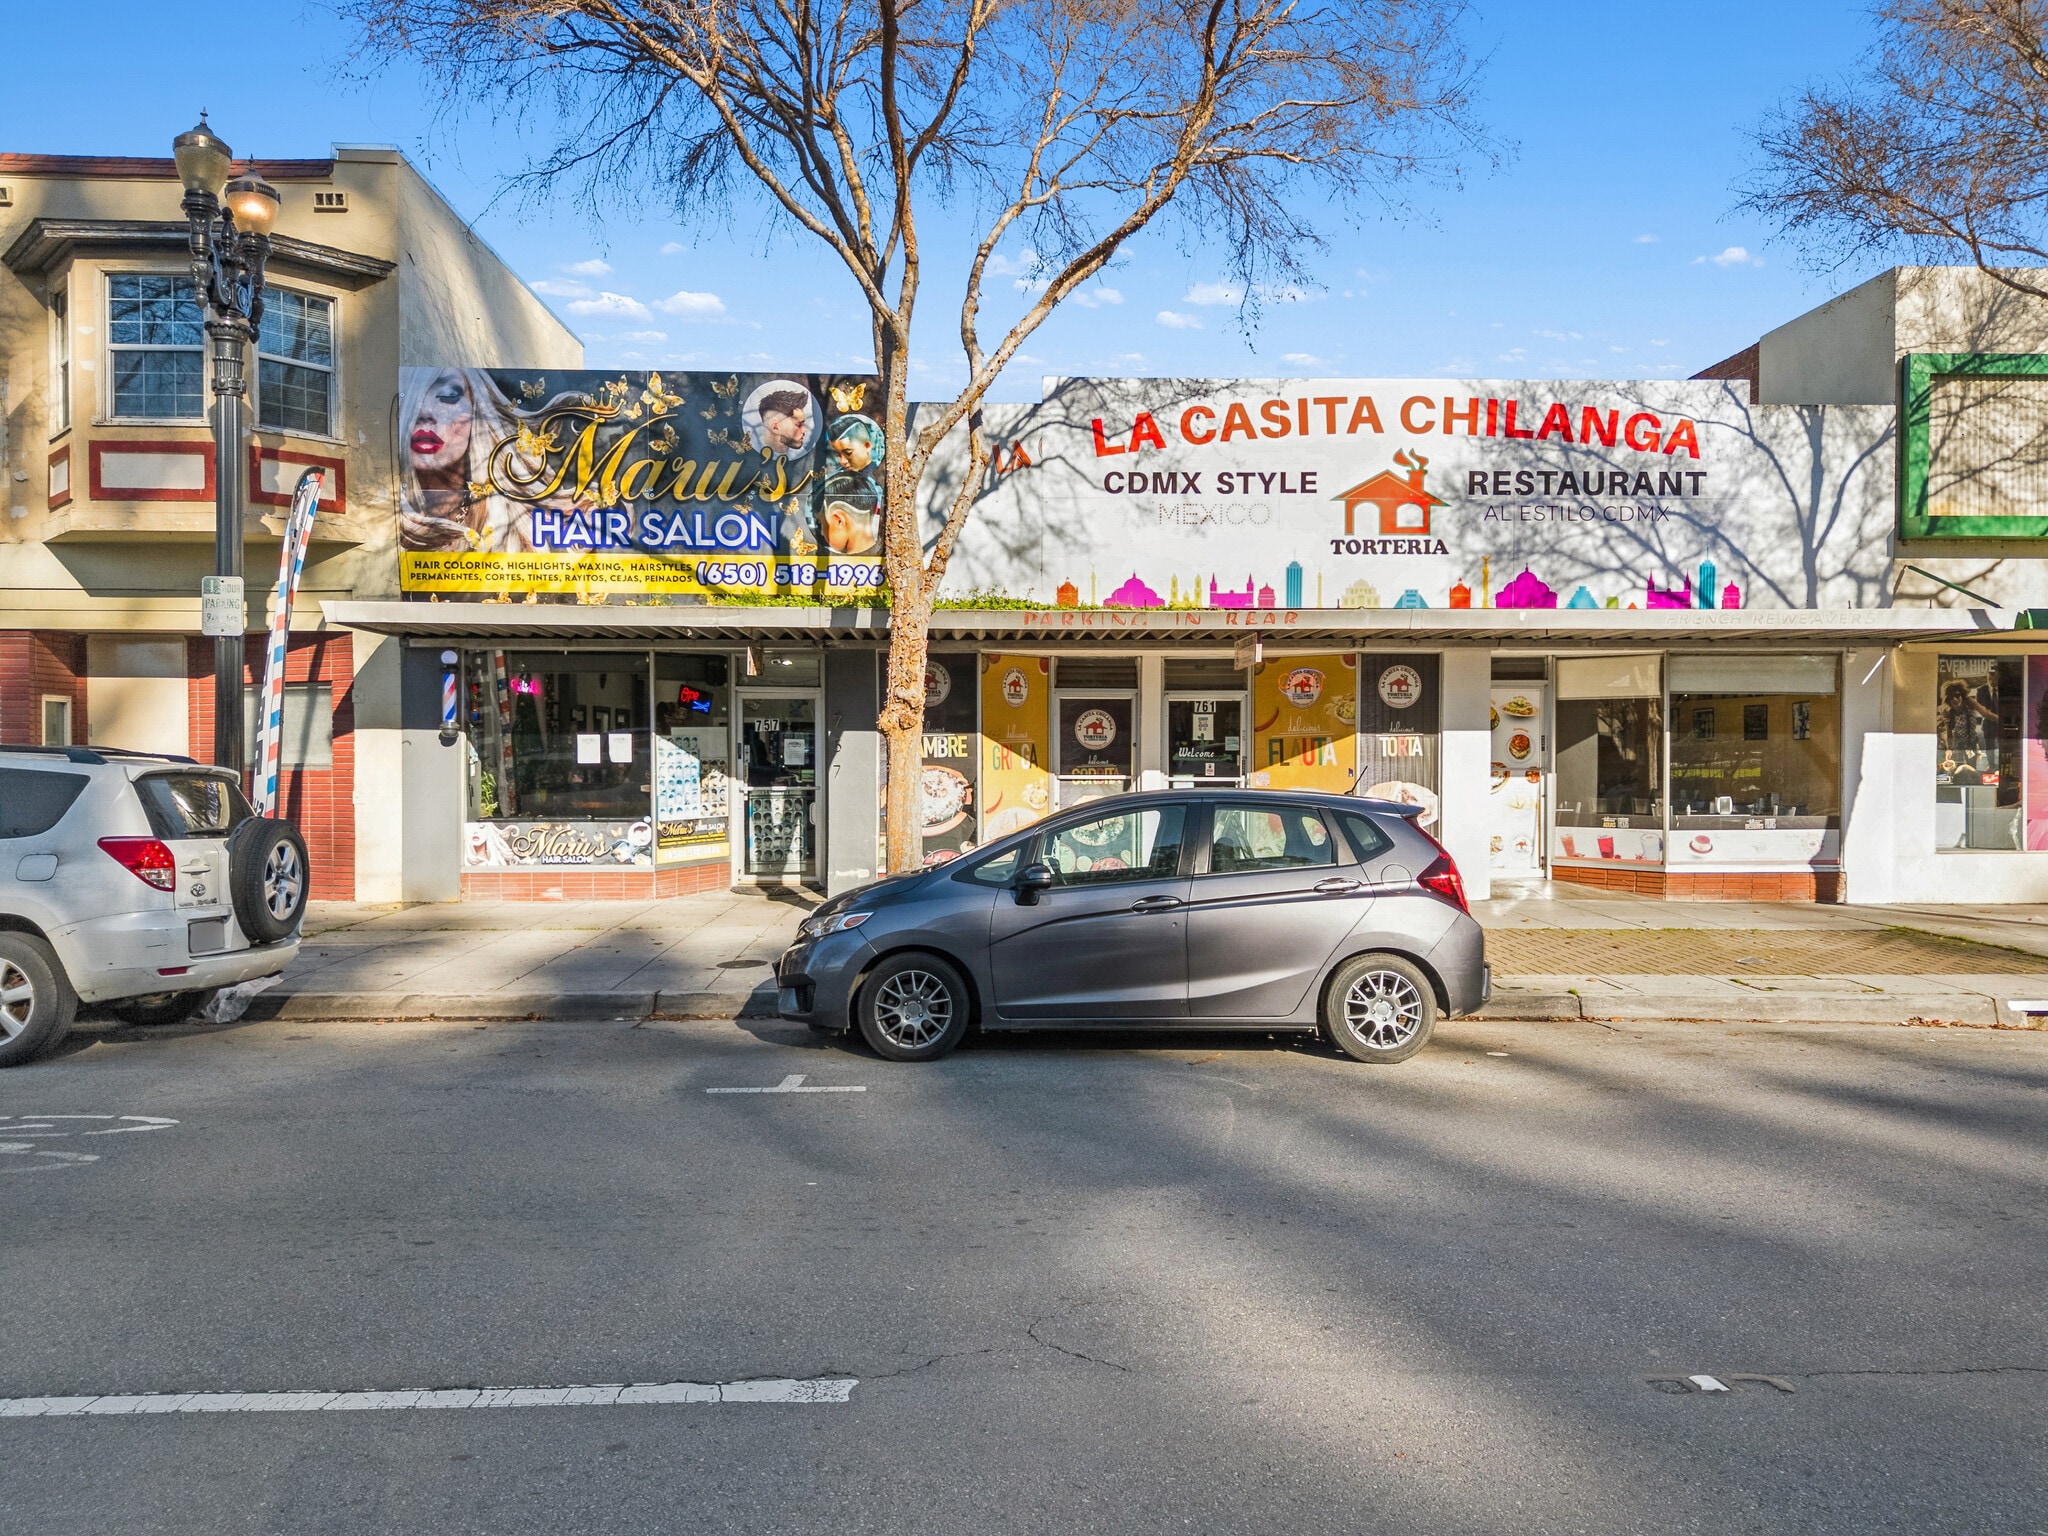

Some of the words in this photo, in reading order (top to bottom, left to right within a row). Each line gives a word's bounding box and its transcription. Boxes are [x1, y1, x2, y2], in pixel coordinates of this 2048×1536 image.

[1092, 411, 1167, 457] LA
[1180, 396, 1385, 445] CASITA
[1400, 396, 1701, 459] CHILANGA
[488, 413, 816, 502] Maru's
[992, 440, 1032, 474] LA
[1104, 471, 1202, 494] CDMX
[1216, 471, 1318, 494] STYLE
[1468, 470, 1707, 497] RESTAURANT
[1158, 502, 1271, 525] MEXICO
[1484, 505, 1512, 522] AL
[1520, 505, 1595, 522] ESTILO
[1603, 505, 1670, 522] CDMX
[533, 511, 632, 549] HAIR
[641, 511, 780, 550] SALON
[1330, 539, 1449, 555] TORTERIA
[414, 560, 440, 570] HAIR
[443, 561, 503, 571] COLORING,
[507, 562, 575, 571] HIGHLIGHTS,
[578, 563, 624, 571] WAXING,
[631, 563, 692, 572] HAIRSTYLES
[696, 562, 767, 586] (650)
[775, 564, 886, 587] 518-1996
[410, 573, 482, 581] PERMANENTES,
[485, 573, 525, 582] CORTES,
[527, 574, 562, 582] TINTES,
[565, 575, 607, 583] RAYITOS,
[610, 575, 643, 583] CEJAS,
[645, 575, 692, 583] PEINADOS
[1023, 611, 1148, 626] PARKING
[1175, 611, 1201, 626] IN
[1225, 611, 1298, 626] REAR
[1665, 613, 1742, 625] FRENCH
[1969, 659, 1996, 673] HIDE
[1195, 701, 1215, 712] 761
[755, 719, 779, 731] 757
[992, 744, 1038, 771] GRIGA
[1268, 737, 1337, 766] FLAUTA
[1379, 737, 1423, 757] TORTA
[512, 829, 611, 857] Maru's
[541, 856, 560, 864] HAIR
[563, 856, 591, 865] SALON
